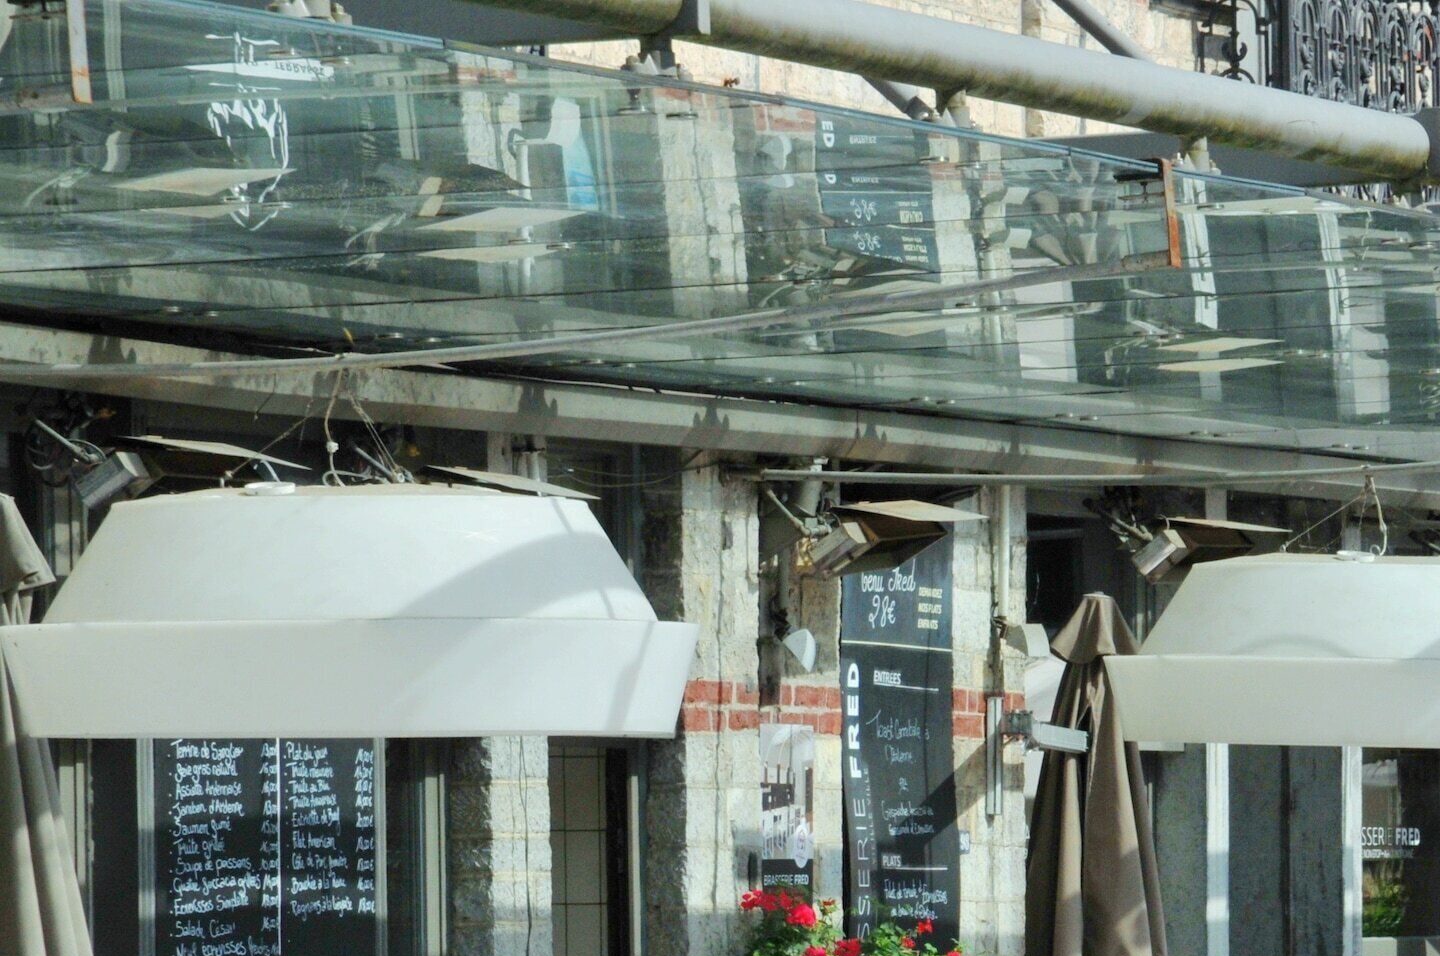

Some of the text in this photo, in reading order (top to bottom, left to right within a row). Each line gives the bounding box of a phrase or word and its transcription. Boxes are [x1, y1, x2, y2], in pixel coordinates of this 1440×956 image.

[868, 594, 896, 629] 28€
[873, 670, 901, 684] ENTREES
[845, 662, 862, 778] FRED
[1395, 827, 1421, 846] FRED
[882, 855, 901, 867] PLATS
[794, 874, 810, 886] FRED
